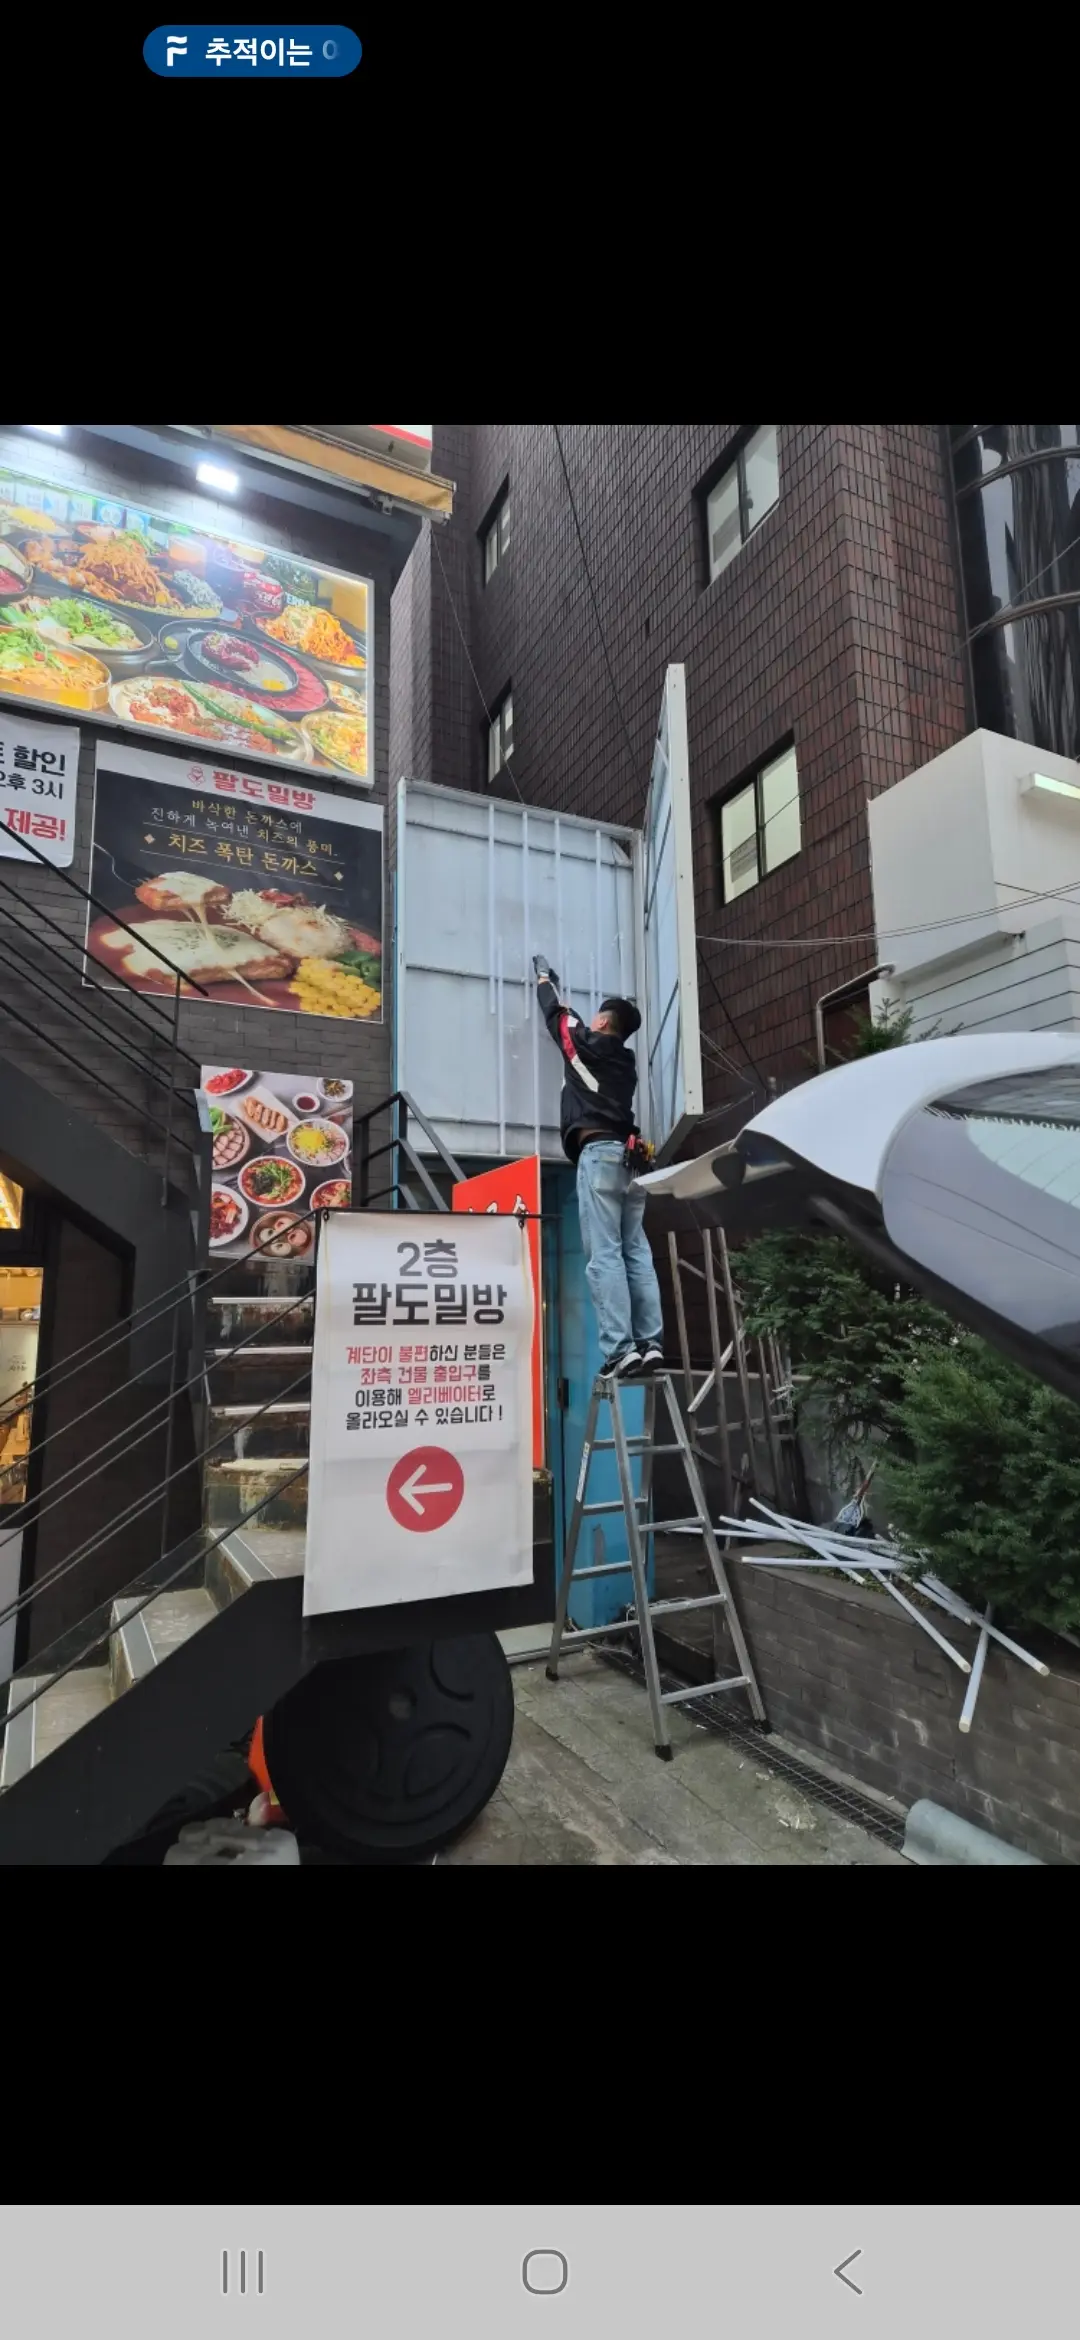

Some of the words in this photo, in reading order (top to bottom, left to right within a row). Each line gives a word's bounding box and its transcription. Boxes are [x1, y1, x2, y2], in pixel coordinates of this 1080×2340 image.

[13, 745, 65, 776] 할인
[32, 778, 63, 799] 3시
[212, 770, 316, 811] 팔도밀방
[4, 807, 66, 841] 제공!
[151, 807, 196, 827] 진하게
[206, 817, 249, 838] 녹여낸
[256, 828, 299, 848] 치즈의
[192, 800, 237, 819] 바삭한
[246, 810, 302, 833] 돈까스에
[168, 833, 208, 855] 치즈
[215, 842, 254, 866] 폭탄
[261, 852, 318, 877] 돈까스
[396, 1238, 459, 1278] 2층
[352, 1282, 507, 1326] 팔도밀방
[346, 1346, 392, 1364] 계단이
[399, 1344, 459, 1363] 불편하신
[464, 1343, 506, 1361] 분들은
[361, 1367, 392, 1386] 좌측
[398, 1365, 428, 1384] 건물
[433, 1364, 491, 1383] 출입구를
[355, 1388, 403, 1407] 이용해
[408, 1384, 496, 1405] 엘리베이터로
[346, 1409, 409, 1430] 올라오실
[414, 1408, 429, 1426] 수
